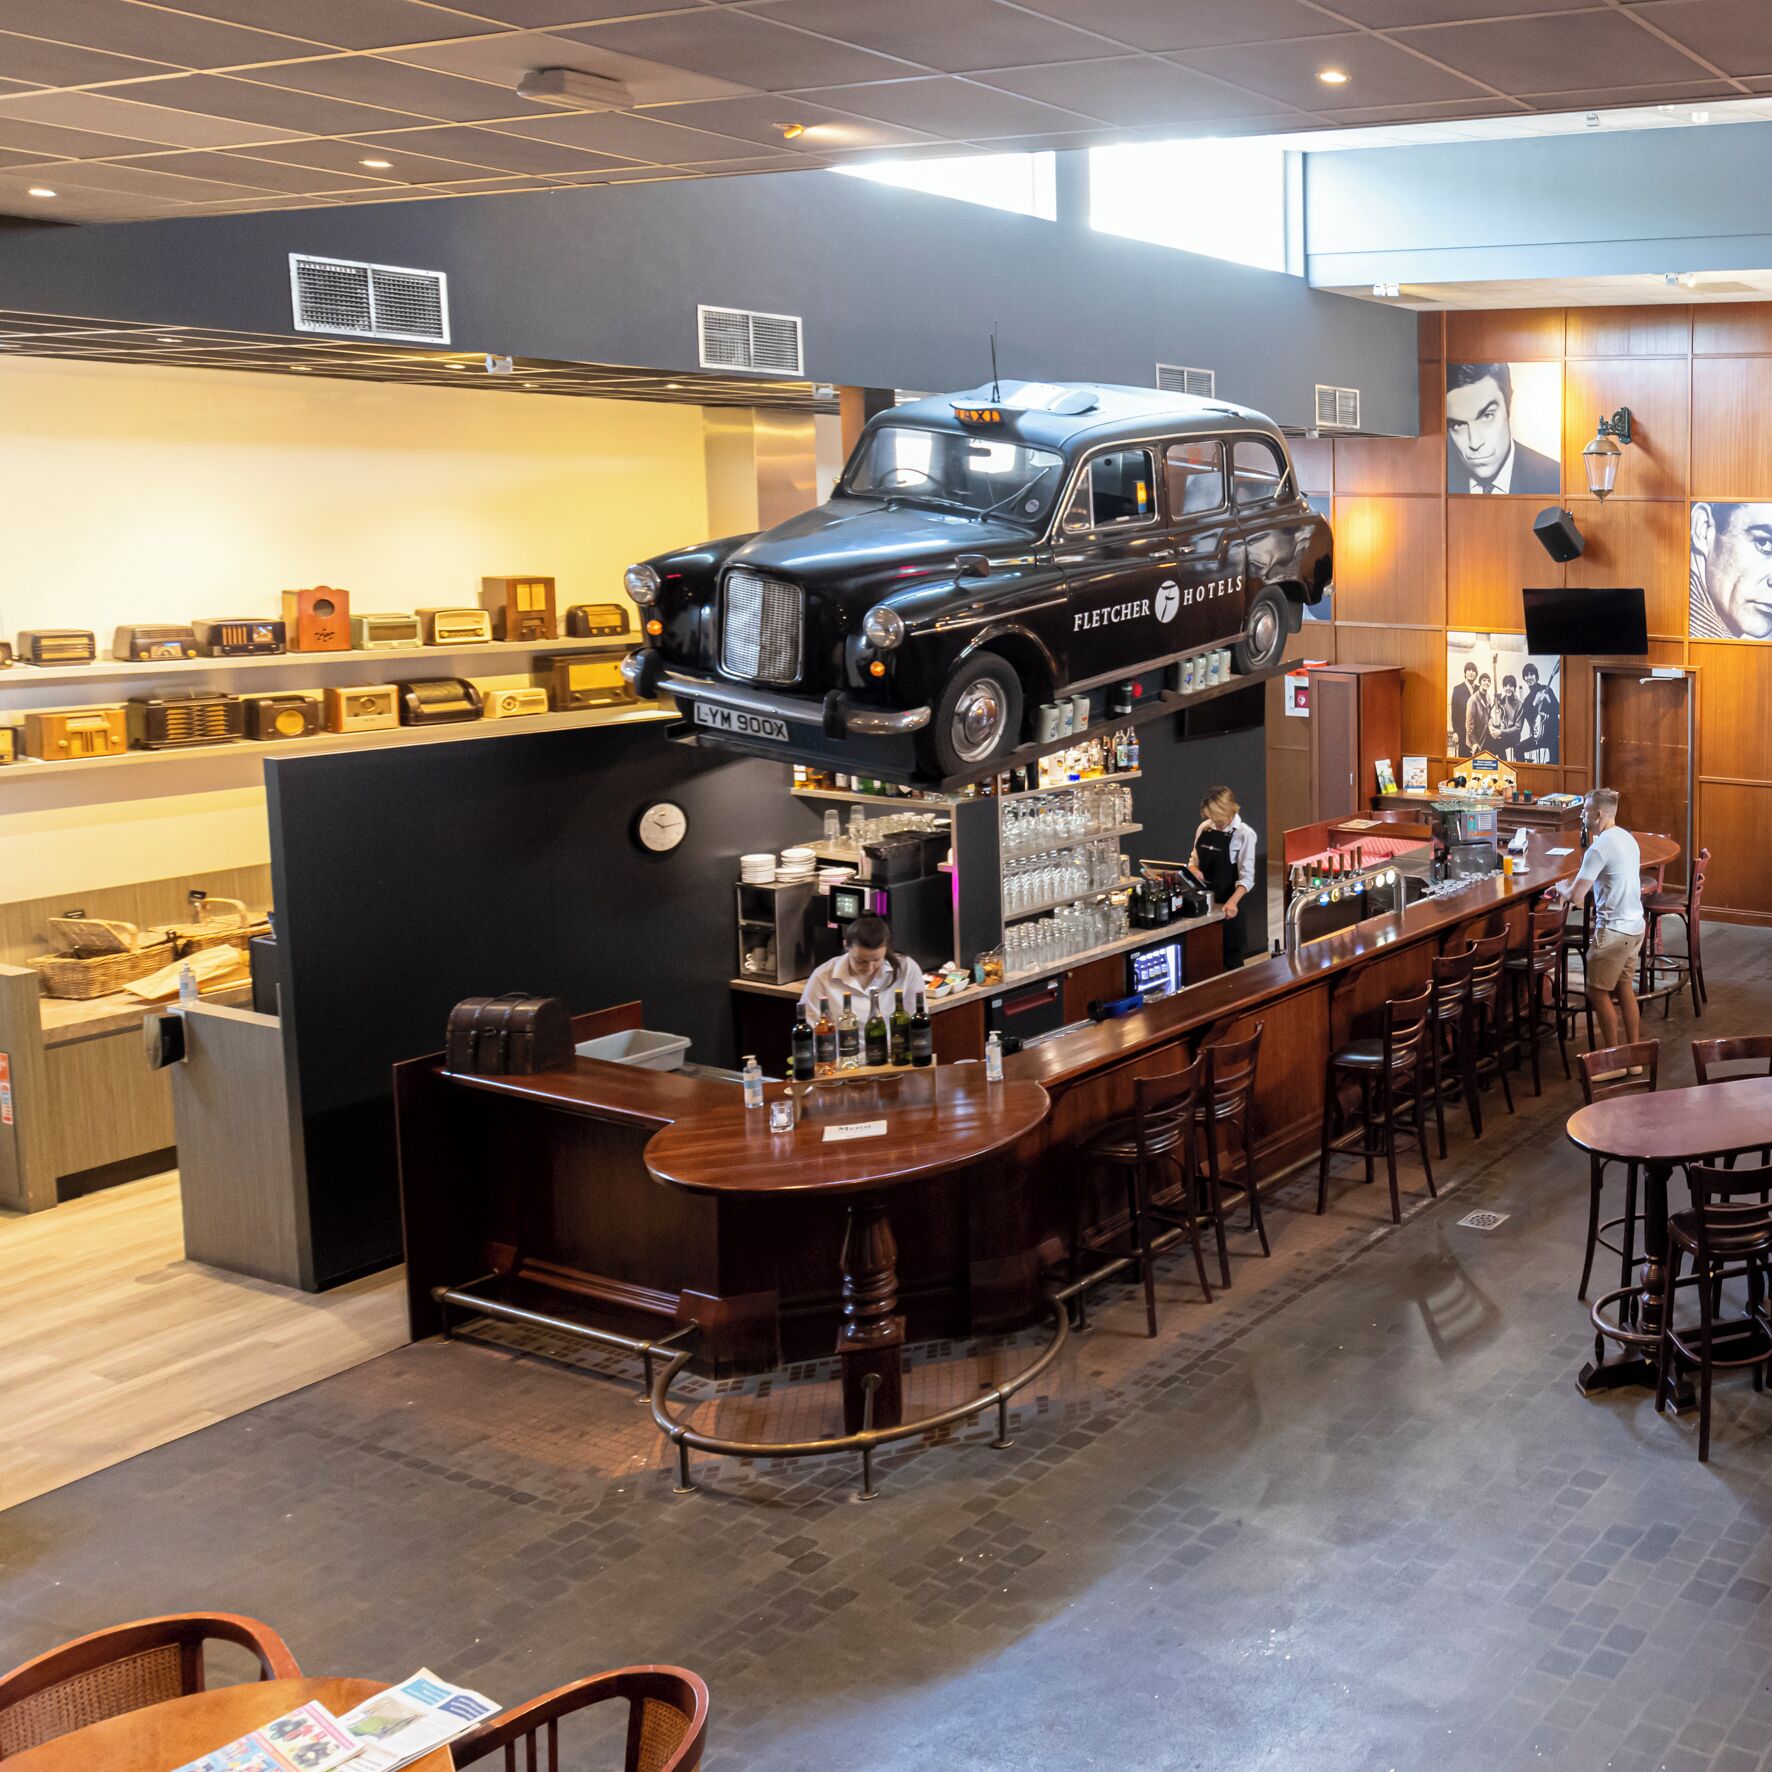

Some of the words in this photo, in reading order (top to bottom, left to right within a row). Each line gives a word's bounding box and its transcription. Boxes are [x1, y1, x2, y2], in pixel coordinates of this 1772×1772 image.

[955, 409, 1000, 423] TAXI
[1073, 599, 1151, 632] FLETCHER
[1183, 575, 1243, 606] HOTELS
[697, 705, 731, 728] LYM
[737, 714, 787, 739] 900X
